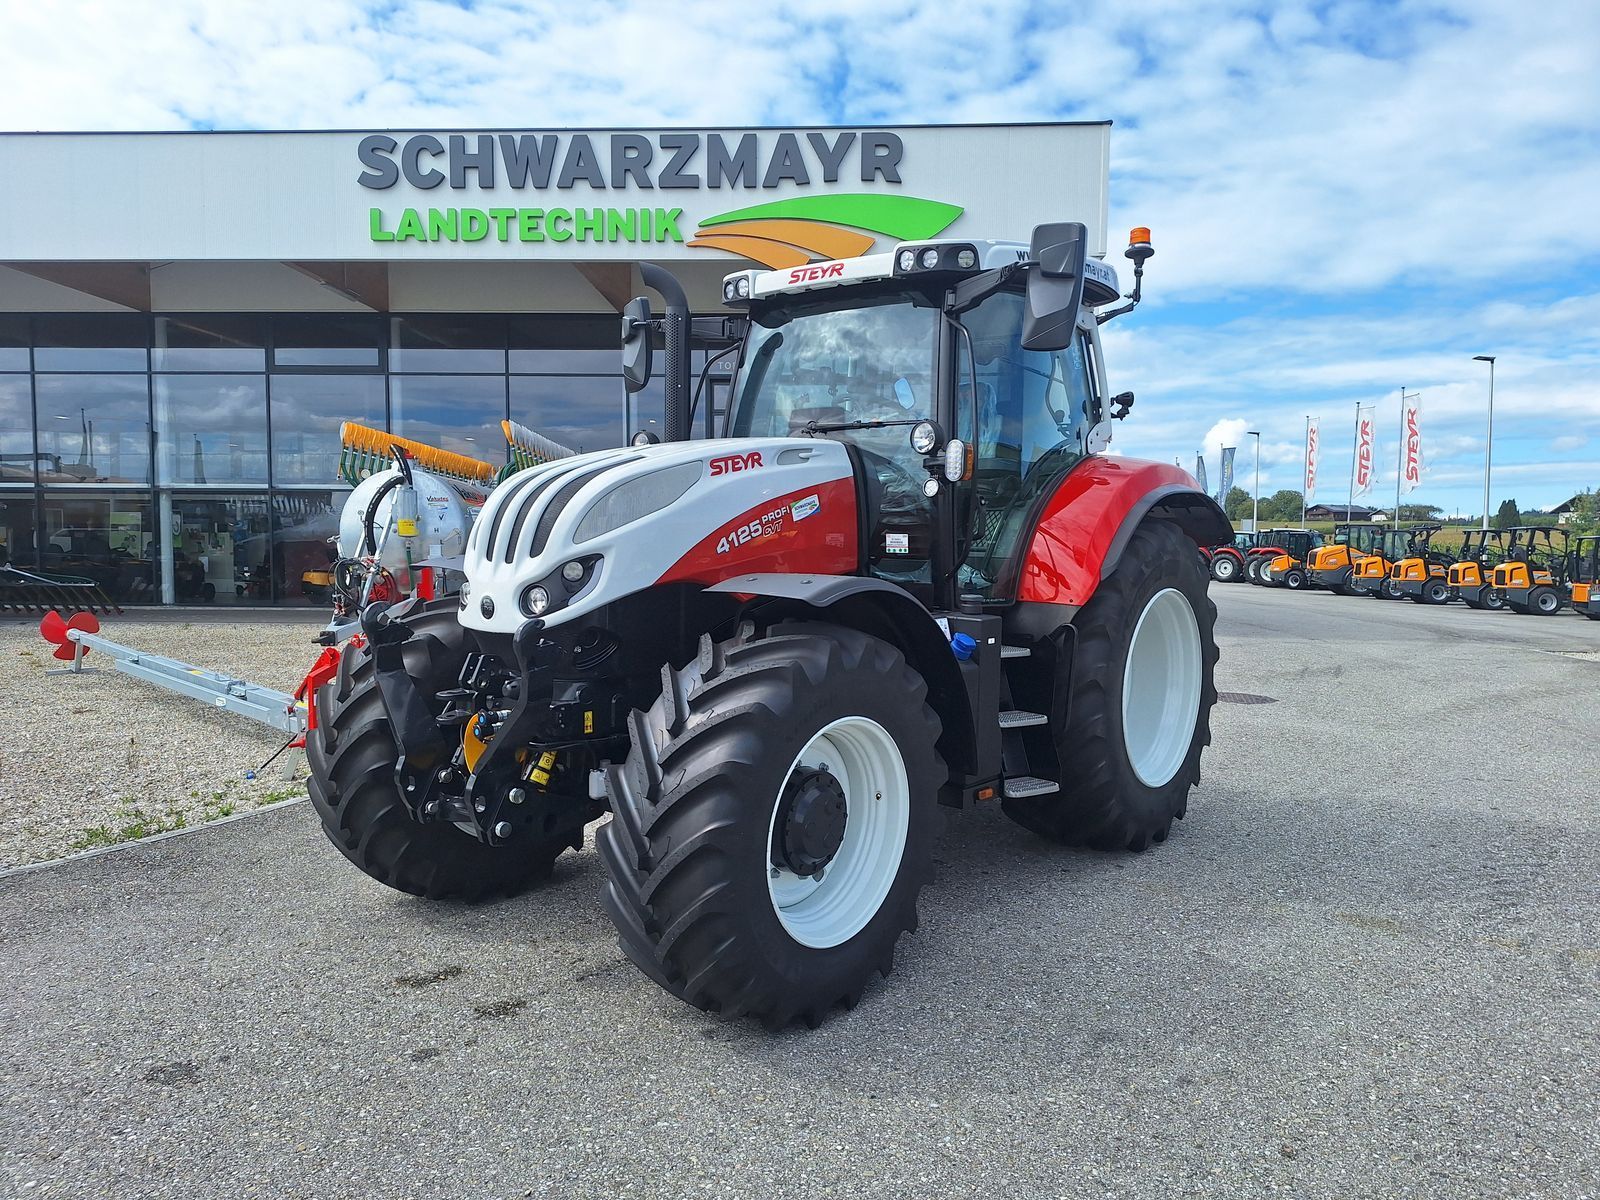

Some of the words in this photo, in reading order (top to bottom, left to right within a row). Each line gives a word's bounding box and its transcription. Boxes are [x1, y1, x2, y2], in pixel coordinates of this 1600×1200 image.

[357, 131, 903, 190] SCHWARZMAYR
[370, 207, 684, 243] LANDTECHNIK
[788, 262, 845, 285] STEYR
[709, 451, 764, 477] STEYR
[1357, 419, 1371, 488] STEYR
[1406, 408, 1419, 483] STEYR
[716, 519, 763, 555] 4125
[761, 505, 790, 524] PROFI
[762, 519, 783, 538] CVT
